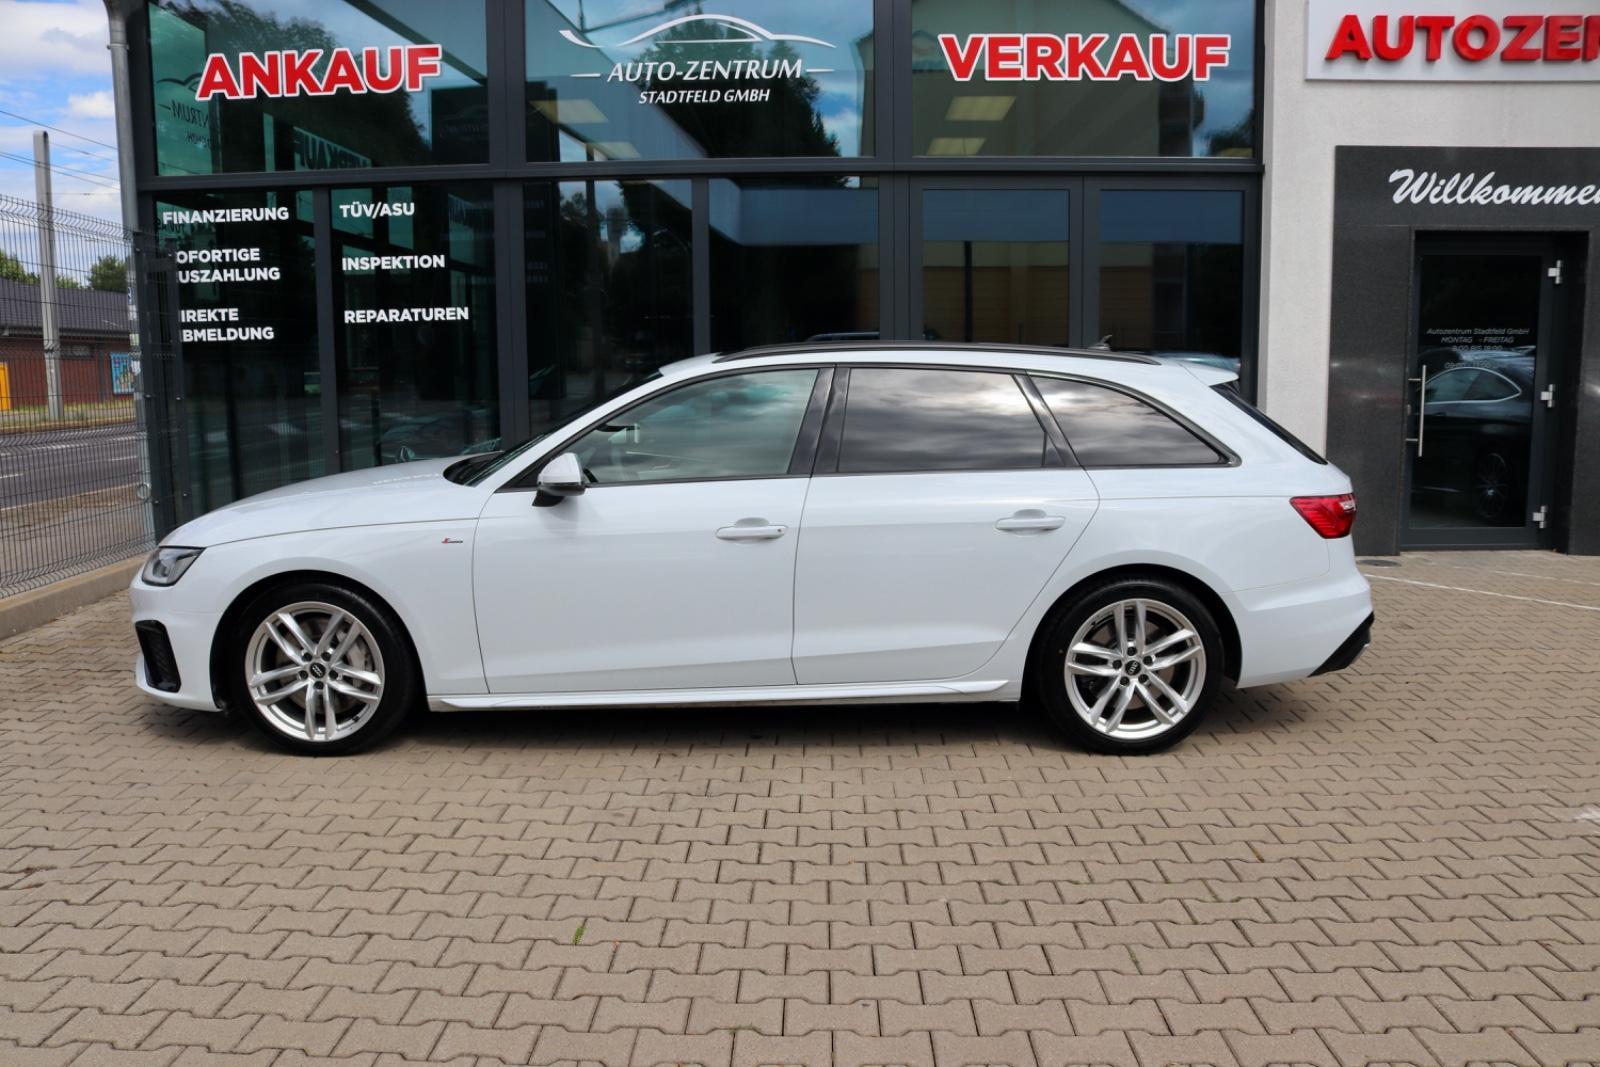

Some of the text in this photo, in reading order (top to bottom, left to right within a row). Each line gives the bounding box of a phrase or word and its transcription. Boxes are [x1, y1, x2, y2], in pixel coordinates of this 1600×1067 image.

[938, 33, 1232, 82] VERKAUF
[195, 44, 442, 101] ANKAUF
[607, 59, 803, 83] AUTO-ZENTRUM
[638, 88, 770, 105] STADTFELD GMBH
[162, 206, 290, 225] FINANZIERUNG
[339, 201, 415, 220] TÜV/ASU
[176, 247, 261, 264] OFORTIGE
[341, 254, 446, 272] INSPEKTION
[177, 266, 281, 284] USZAHLUNG
[178, 307, 240, 323] IREKTE
[344, 306, 470, 325] REPARATUREN
[180, 326, 275, 343] BMELDUNG
